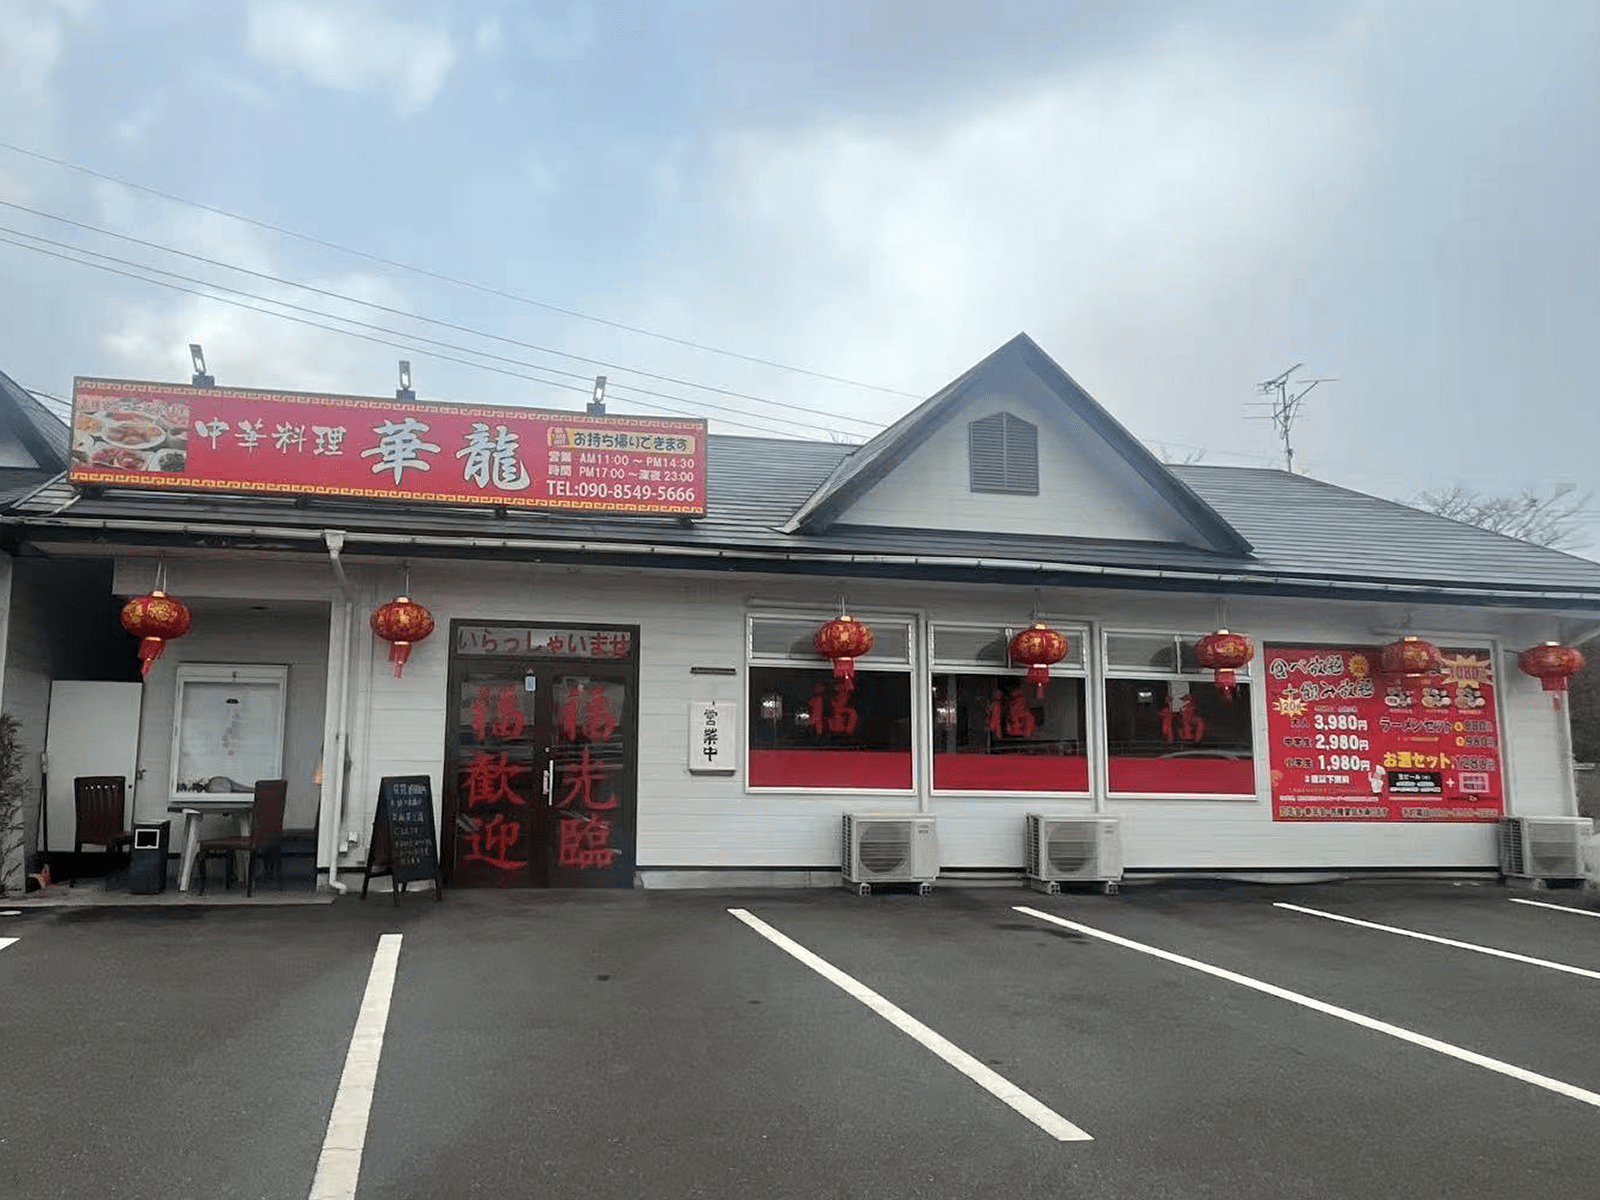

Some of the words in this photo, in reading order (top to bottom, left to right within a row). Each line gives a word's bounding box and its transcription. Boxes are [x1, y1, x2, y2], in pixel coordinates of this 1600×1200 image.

[574, 432, 688, 451] お持ち帰りできます
[195, 417, 347, 455] 中華料理
[360, 417, 531, 491] 華龍
[579, 452, 629, 466] AM11:00
[646, 456, 695, 469] PM14:30
[546, 479, 695, 501] TEL:090-8549-5666
[459, 629, 632, 658] いらっしゃいませ
[1314, 714, 1368, 731] 3,980円
[703, 708, 719, 762] 営業中
[1315, 734, 1370, 751] 2,980円
[1317, 754, 1371, 771] 1,980円
